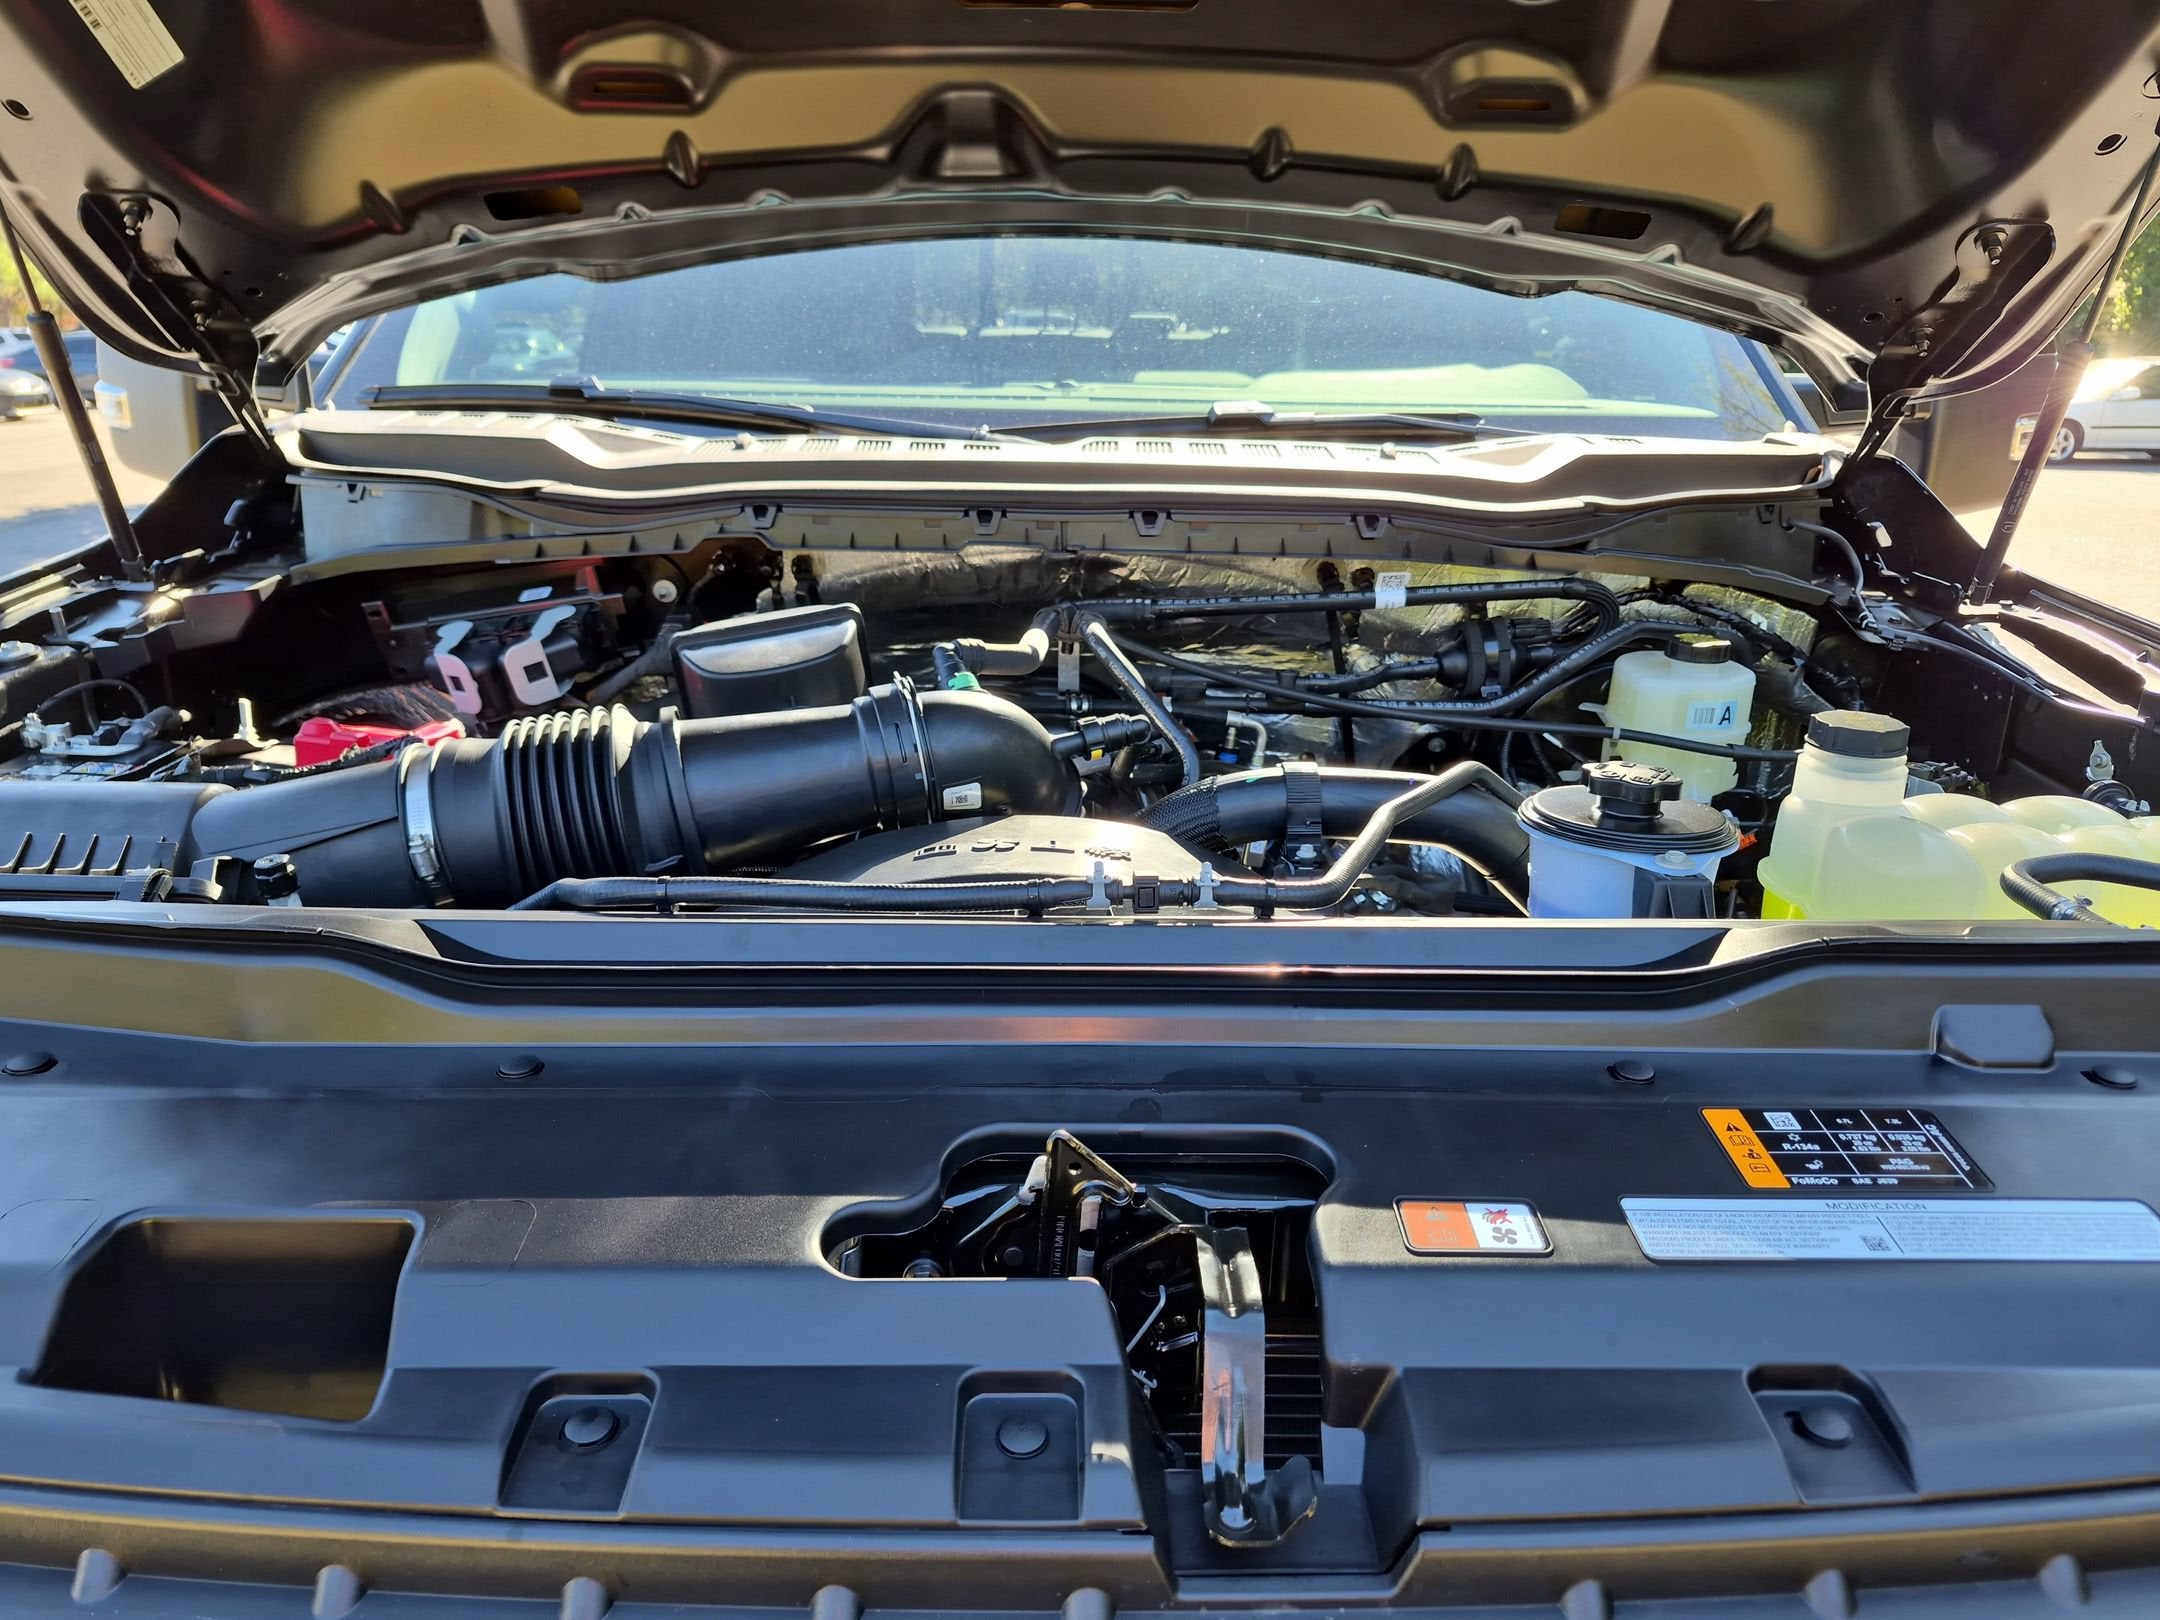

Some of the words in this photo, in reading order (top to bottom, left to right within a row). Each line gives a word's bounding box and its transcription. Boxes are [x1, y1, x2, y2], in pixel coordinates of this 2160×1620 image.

[1718, 705, 1731, 725] A
[1782, 1143, 1820, 1151] R-134a
[1790, 1177, 1839, 1185] FoMoCo
[1851, 1177, 1873, 1185] SAE
[1825, 1202, 1928, 1211] MODIFICATION
